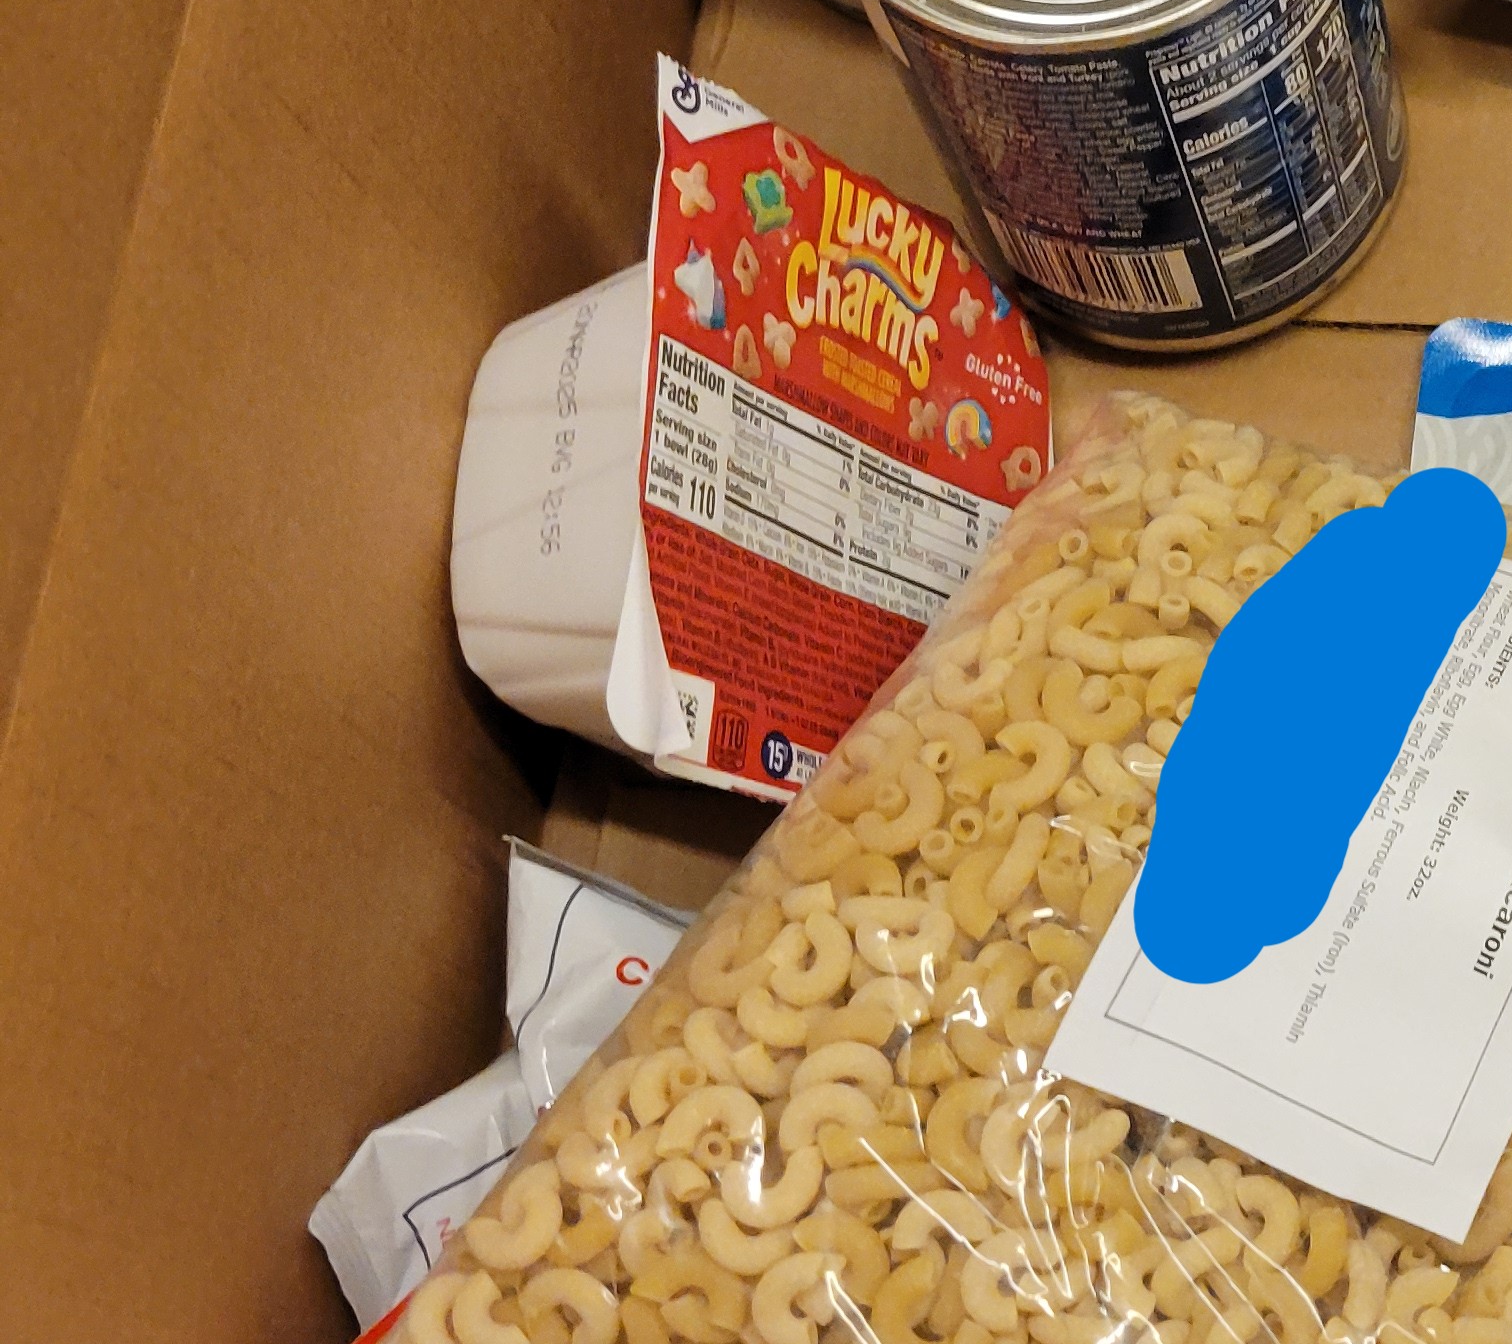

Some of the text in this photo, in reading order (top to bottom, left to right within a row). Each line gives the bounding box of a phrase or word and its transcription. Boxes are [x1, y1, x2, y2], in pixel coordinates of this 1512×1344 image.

[1160, 12, 1273, 84] Nutrition
[1167, 76, 1204, 100] About
[1221, 37, 1270, 77] servings
[1169, 79, 1227, 110] Serving
[1231, 60, 1258, 83] size
[1284, 63, 1307, 96] 80
[1182, 116, 1250, 153] Calories
[819, 167, 945, 311] Lucky
[786, 242, 940, 390] Charms
[653, 339, 734, 397] Nutrition
[965, 353, 1042, 405] Gluten Free
[652, 372, 705, 415] Facts
[651, 407, 719, 451] Serving size
[659, 432, 691, 458] bowl
[646, 453, 689, 488] Calories
[682, 474, 723, 520] 110
[1472, 624, 1502, 663] Flour,
[1455, 660, 1483, 693] Egg,
[1441, 690, 1467, 720] Egg
[1405, 719, 1431, 749] and
[1419, 718, 1454, 766] White,
[1387, 748, 1416, 784] Folic
[1368, 782, 1399, 825] Acid.
[1392, 764, 1430, 819] Niacin,
[1365, 818, 1404, 879] Ferrous
[1404, 785, 1470, 904] Weight: 32oz.
[1340, 877, 1378, 932] Sulfate
[1312, 928, 1351, 980] (Iron),
[1284, 979, 1326, 1045] Thiamin
